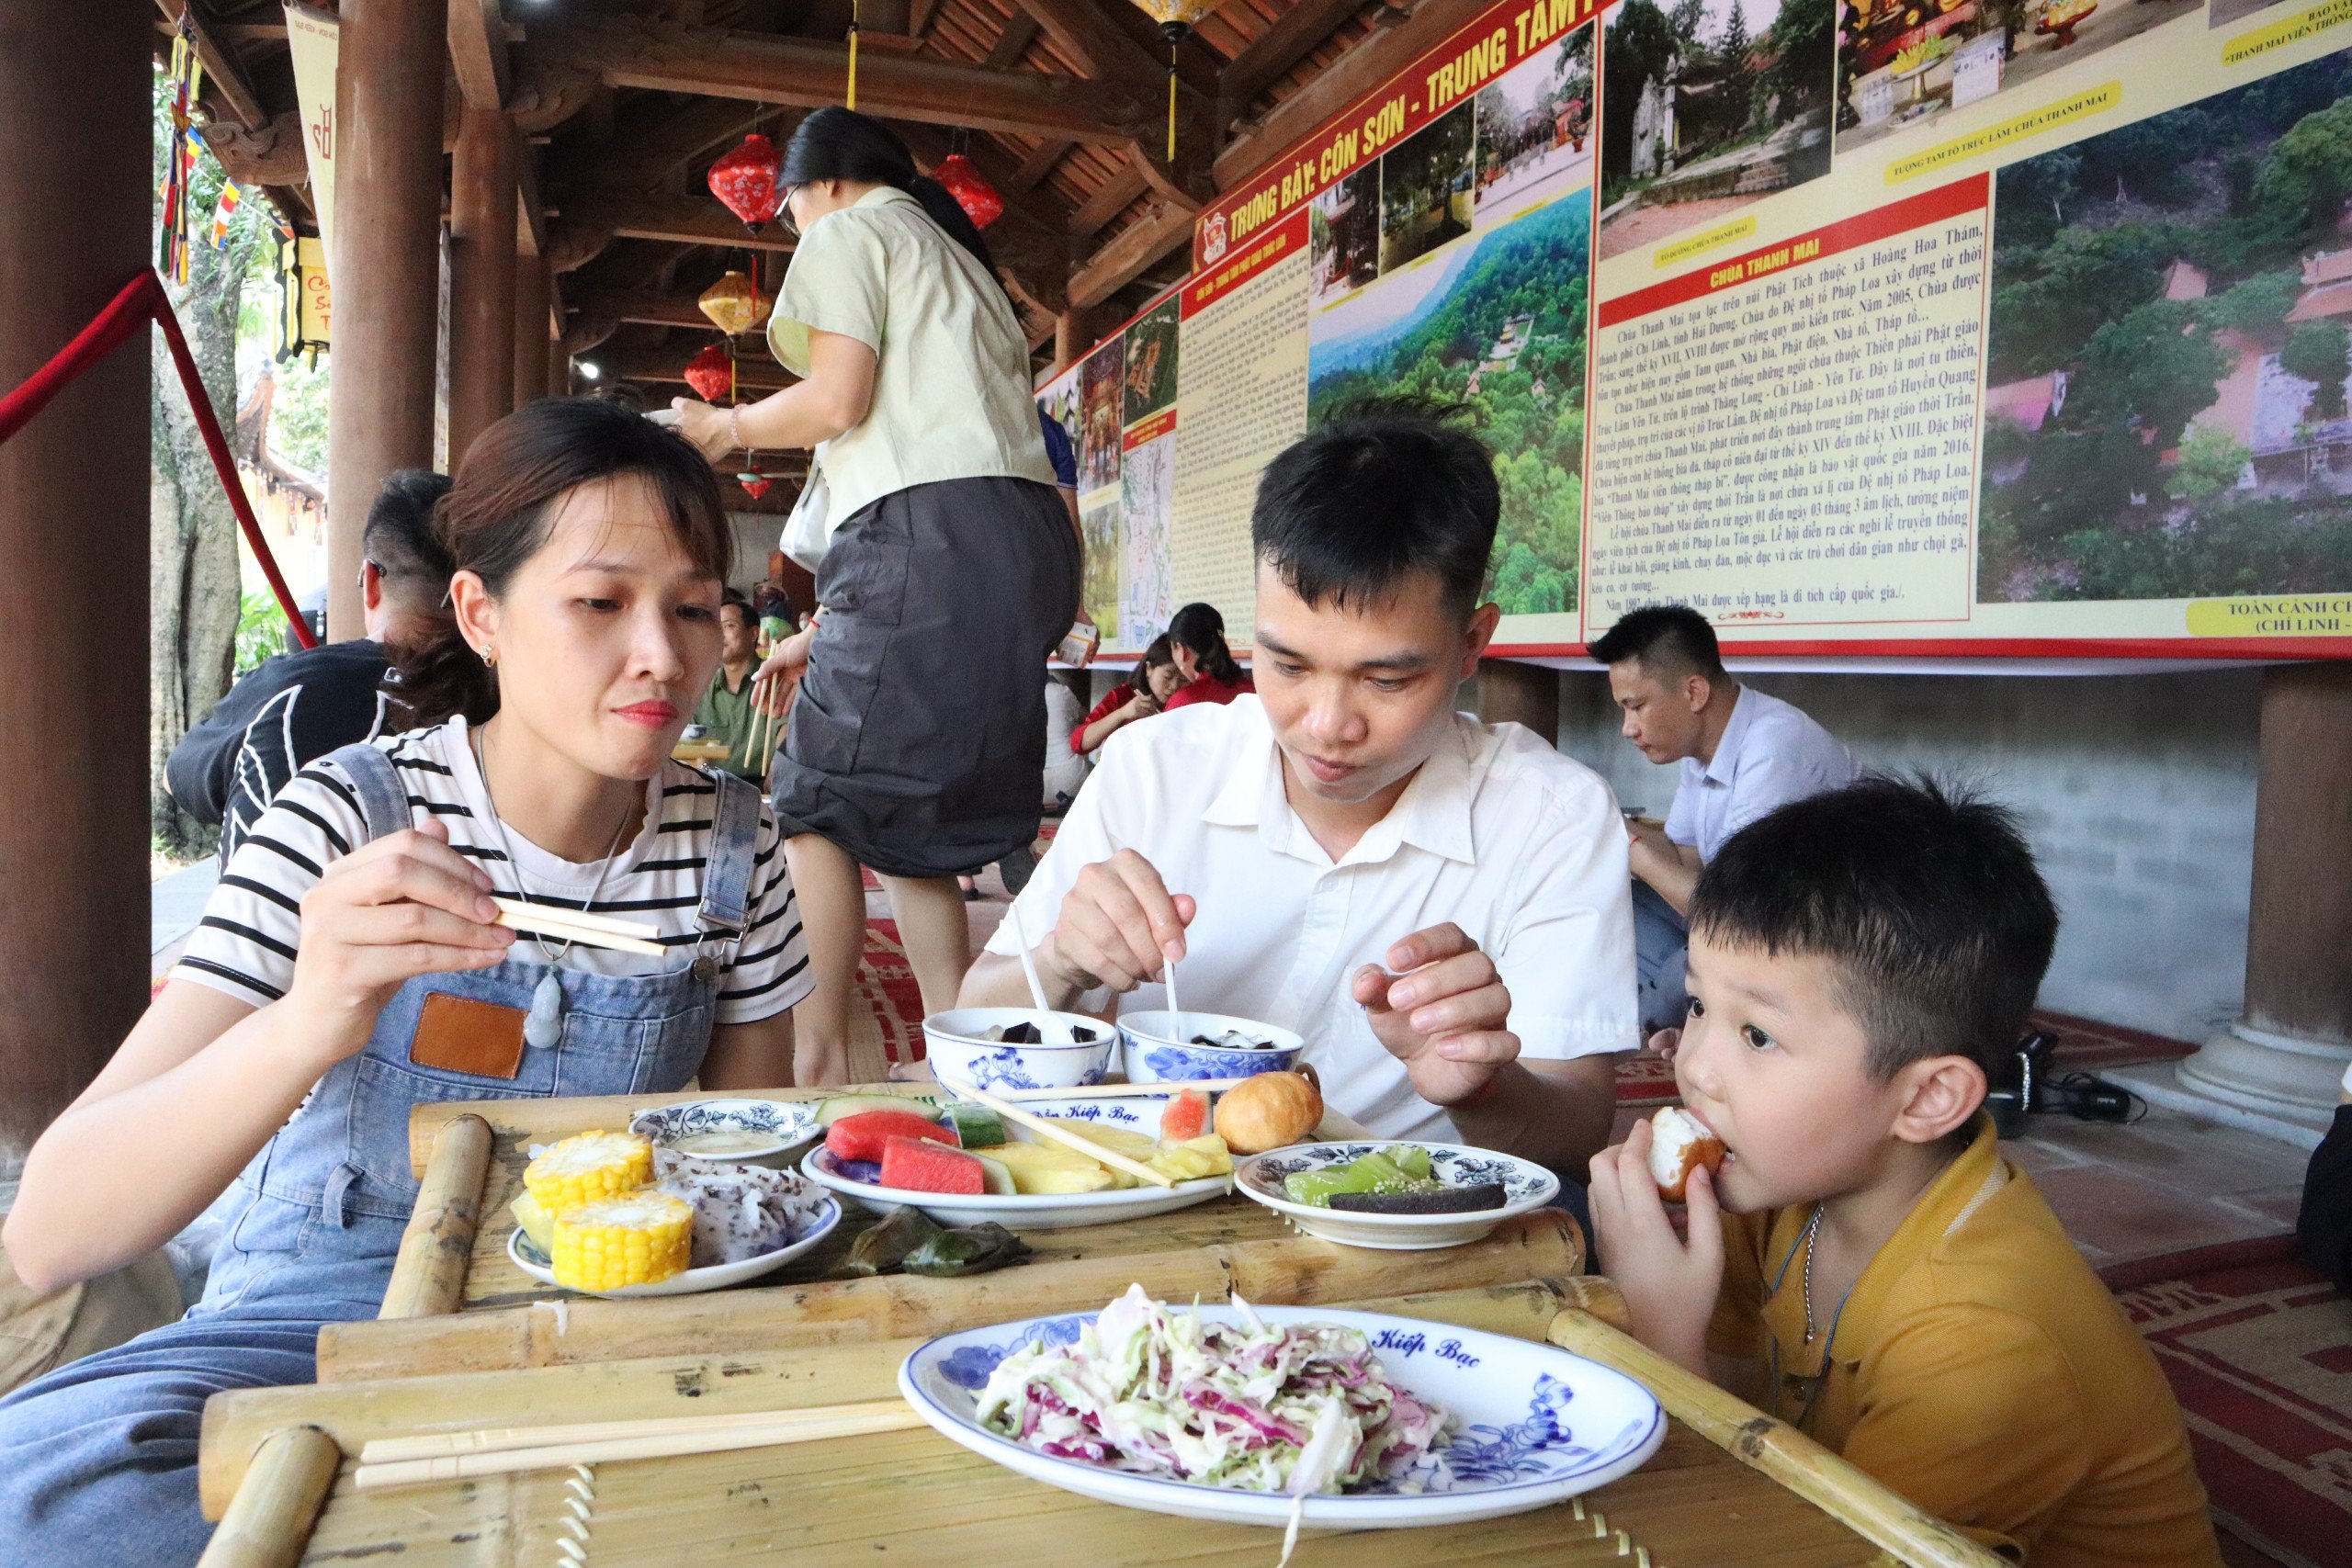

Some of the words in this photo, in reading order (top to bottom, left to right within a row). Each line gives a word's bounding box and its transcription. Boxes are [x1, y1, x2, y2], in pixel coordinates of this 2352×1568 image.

[2265, 35, 2285, 50] MAI
[2288, 26, 2312, 40] VIÊN
[1231, 184, 1278, 242] TRƯNG
[1281, 159, 1316, 210] BÀY:
[1320, 128, 1358, 184] CÔN
[1363, 94, 1405, 155] SƠN
[1410, 102, 1420, 113] -
[1427, 27, 1507, 113] TRUNG
[1926, 152, 1946, 165] TAM
[2047, 103, 2082, 122] THANH
[2086, 92, 2109, 107] MAI
[1733, 224, 1747, 237] MAI
[1915, 239, 1937, 254] Hoa
[1947, 226, 1983, 245] Thám,
[1710, 264, 1744, 288] CHÙA
[1747, 248, 1790, 276] THANH
[1792, 238, 1820, 262] MAI
[1861, 277, 1881, 292] Loa
[1941, 253, 1954, 270] từ
[1959, 244, 1983, 265] thời
[1887, 288, 1914, 308] 2005,
[1917, 280, 1948, 299] Chùa
[1951, 273, 1981, 290] được
[1926, 325, 1951, 344] Phật
[1954, 319, 1979, 341] giáo
[1929, 353, 1940, 366] tu
[1945, 340, 1977, 362] thiền,
[1815, 397, 1834, 411] Loa
[1865, 387, 1884, 400] tam
[1939, 369, 1976, 389] Quang
[1815, 417, 1841, 432] trung
[1918, 395, 1940, 413] thời
[1946, 387, 1974, 409] Trần.
[1813, 437, 1829, 453] XIV
[1890, 422, 1923, 440] XVIII.
[1928, 419, 1949, 437] Đặc
[1952, 412, 1973, 433] biệt
[1892, 447, 1908, 467] gia
[1914, 444, 1937, 459] năm
[1943, 438, 1972, 456] 2016.
[1914, 466, 1940, 484] Pháp
[1946, 463, 1970, 479] Loa.
[1810, 502, 1822, 517] 03
[1854, 497, 1860, 513] 3
[1942, 485, 1969, 506] niệm
[1826, 525, 1836, 537] ra
[1859, 517, 1881, 537] nghi
[1937, 506, 1968, 528] thống
[1871, 540, 1893, 558] gian
[1923, 534, 1946, 554] chọi
[1951, 533, 1967, 553] gà,
[2228, 599, 2273, 616] TOÀN
[2256, 616, 2291, 633] (CHÍ
[2298, 619, 2340, 631] LINH
[1066, 1104, 1102, 1122] Kiếp
[1108, 1106, 1139, 1124] Bạc
[1372, 1329, 1426, 1358] Kiếp
[1435, 1338, 1480, 1369] Bạc
